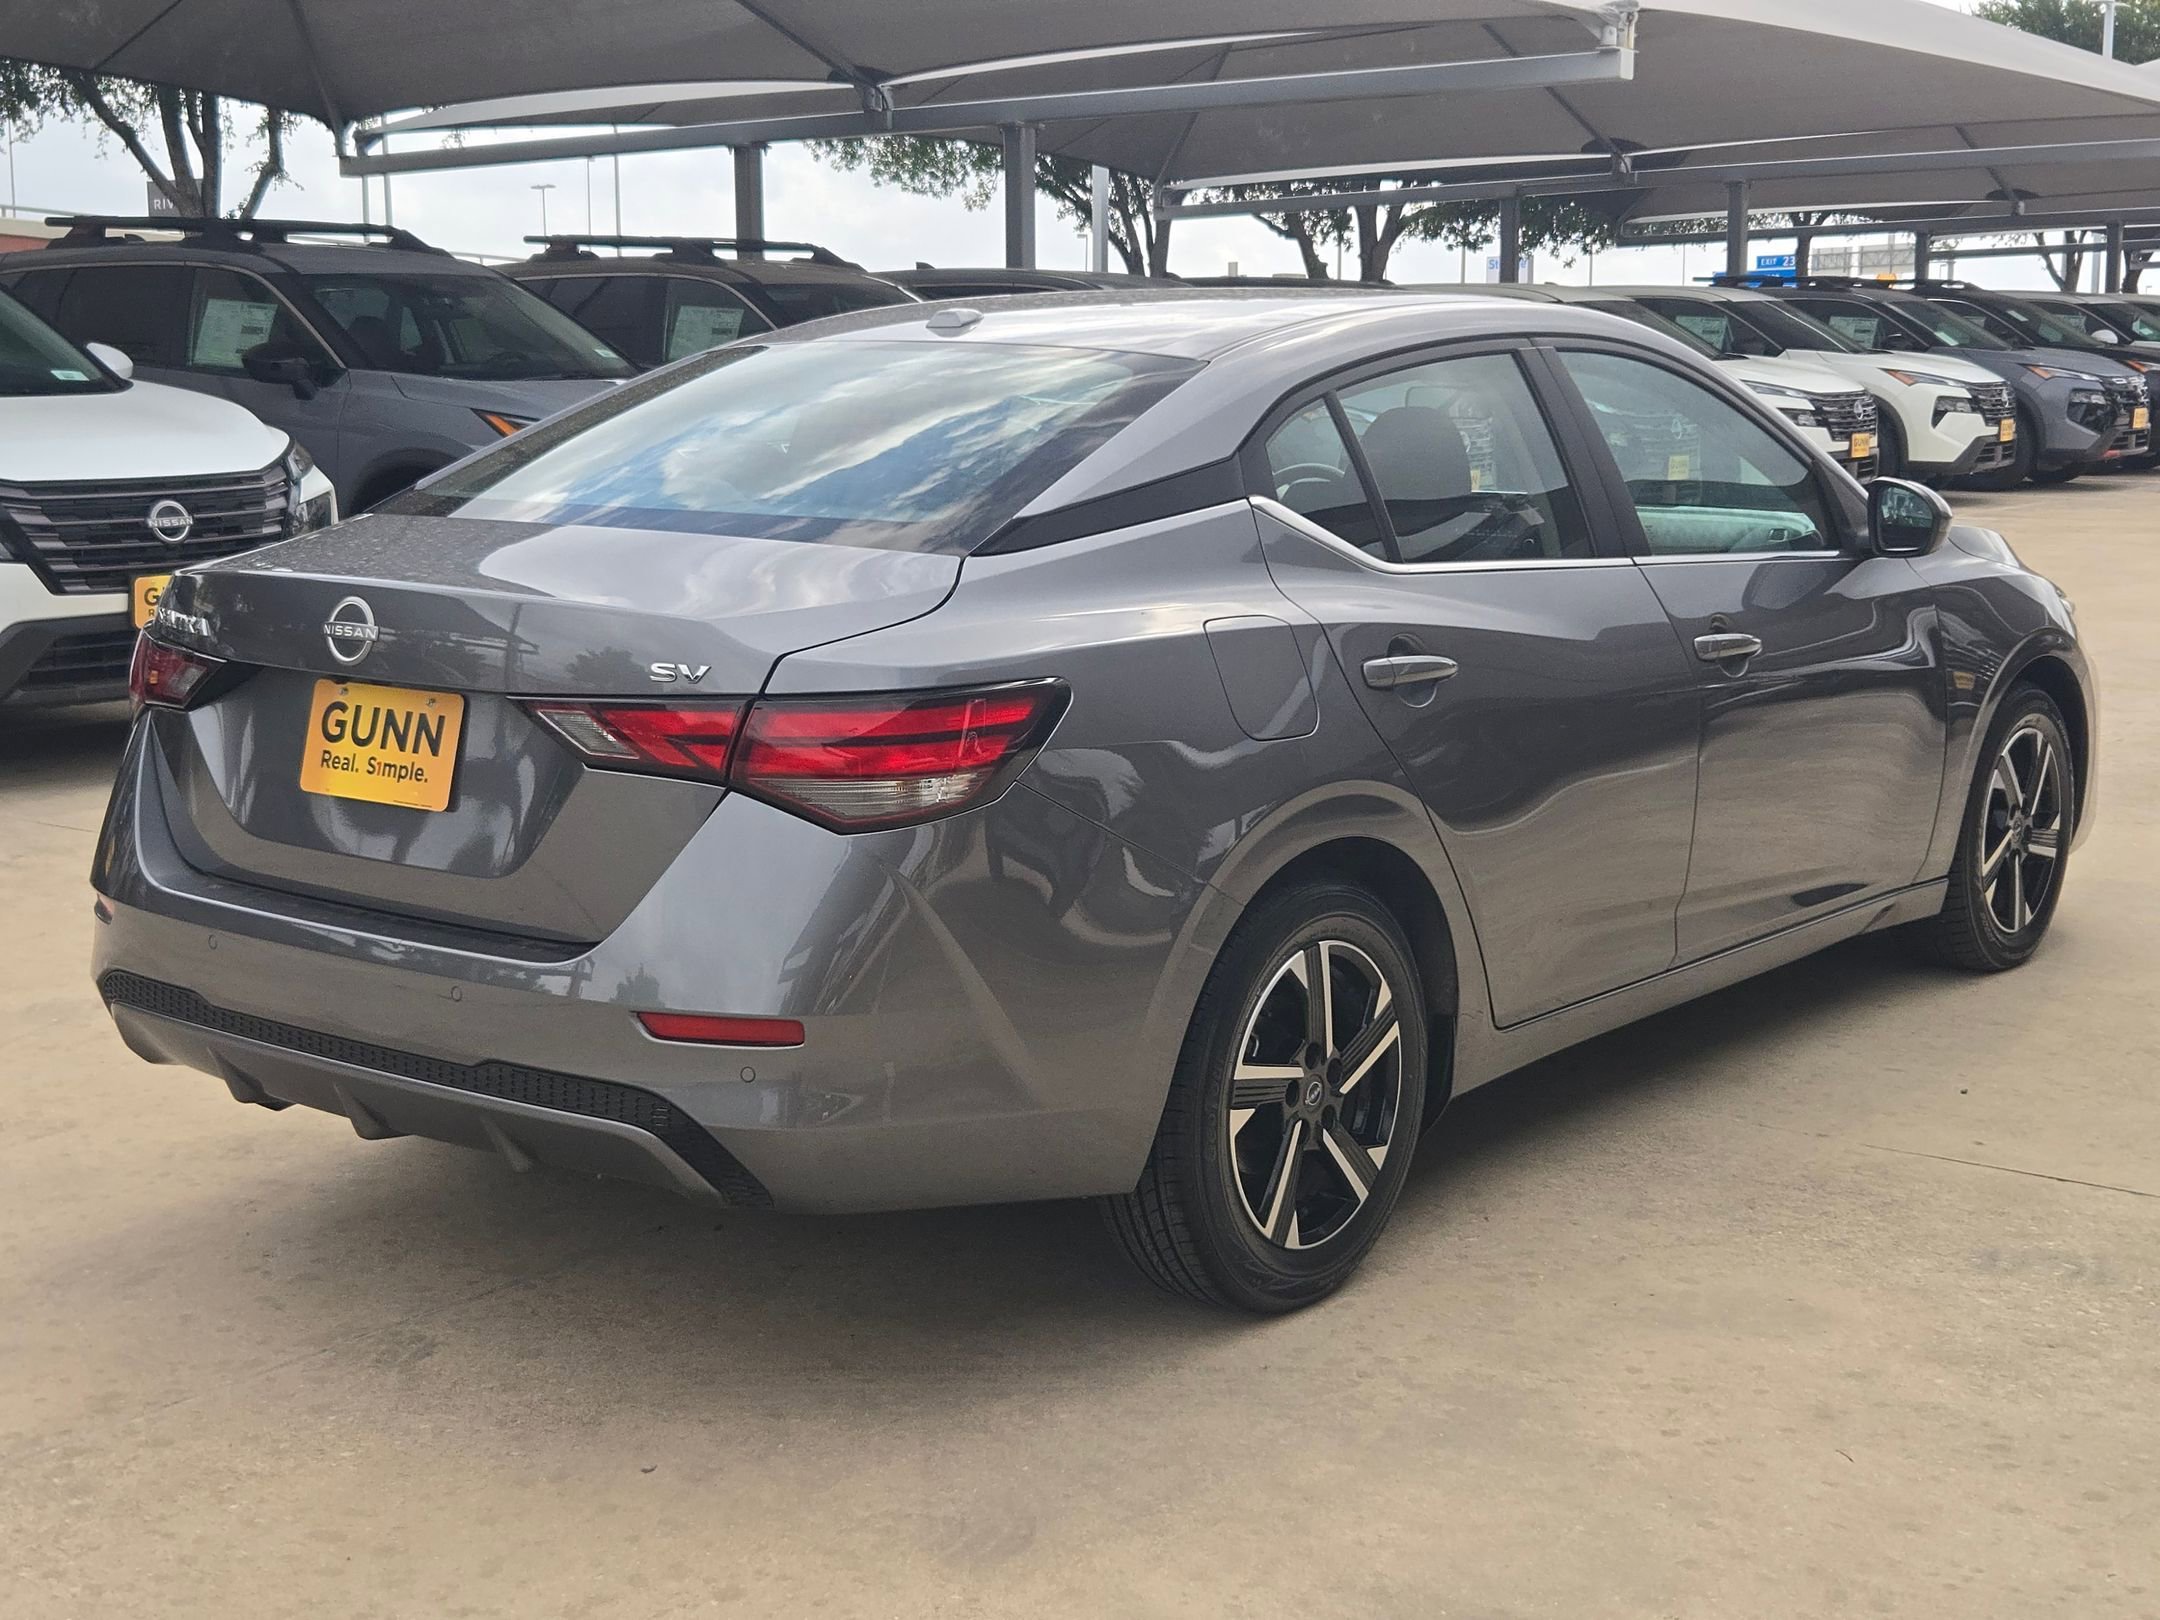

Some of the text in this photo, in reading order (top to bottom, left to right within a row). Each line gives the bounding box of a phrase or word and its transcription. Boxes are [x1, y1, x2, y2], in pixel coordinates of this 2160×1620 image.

[1760, 256, 1796, 267] EXIT 23
[148, 517, 193, 528] NISSAN
[323, 623, 377, 639] NISSAN
[649, 662, 712, 684] SV
[321, 700, 446, 757] GUNN
[320, 749, 359, 773] Real.
